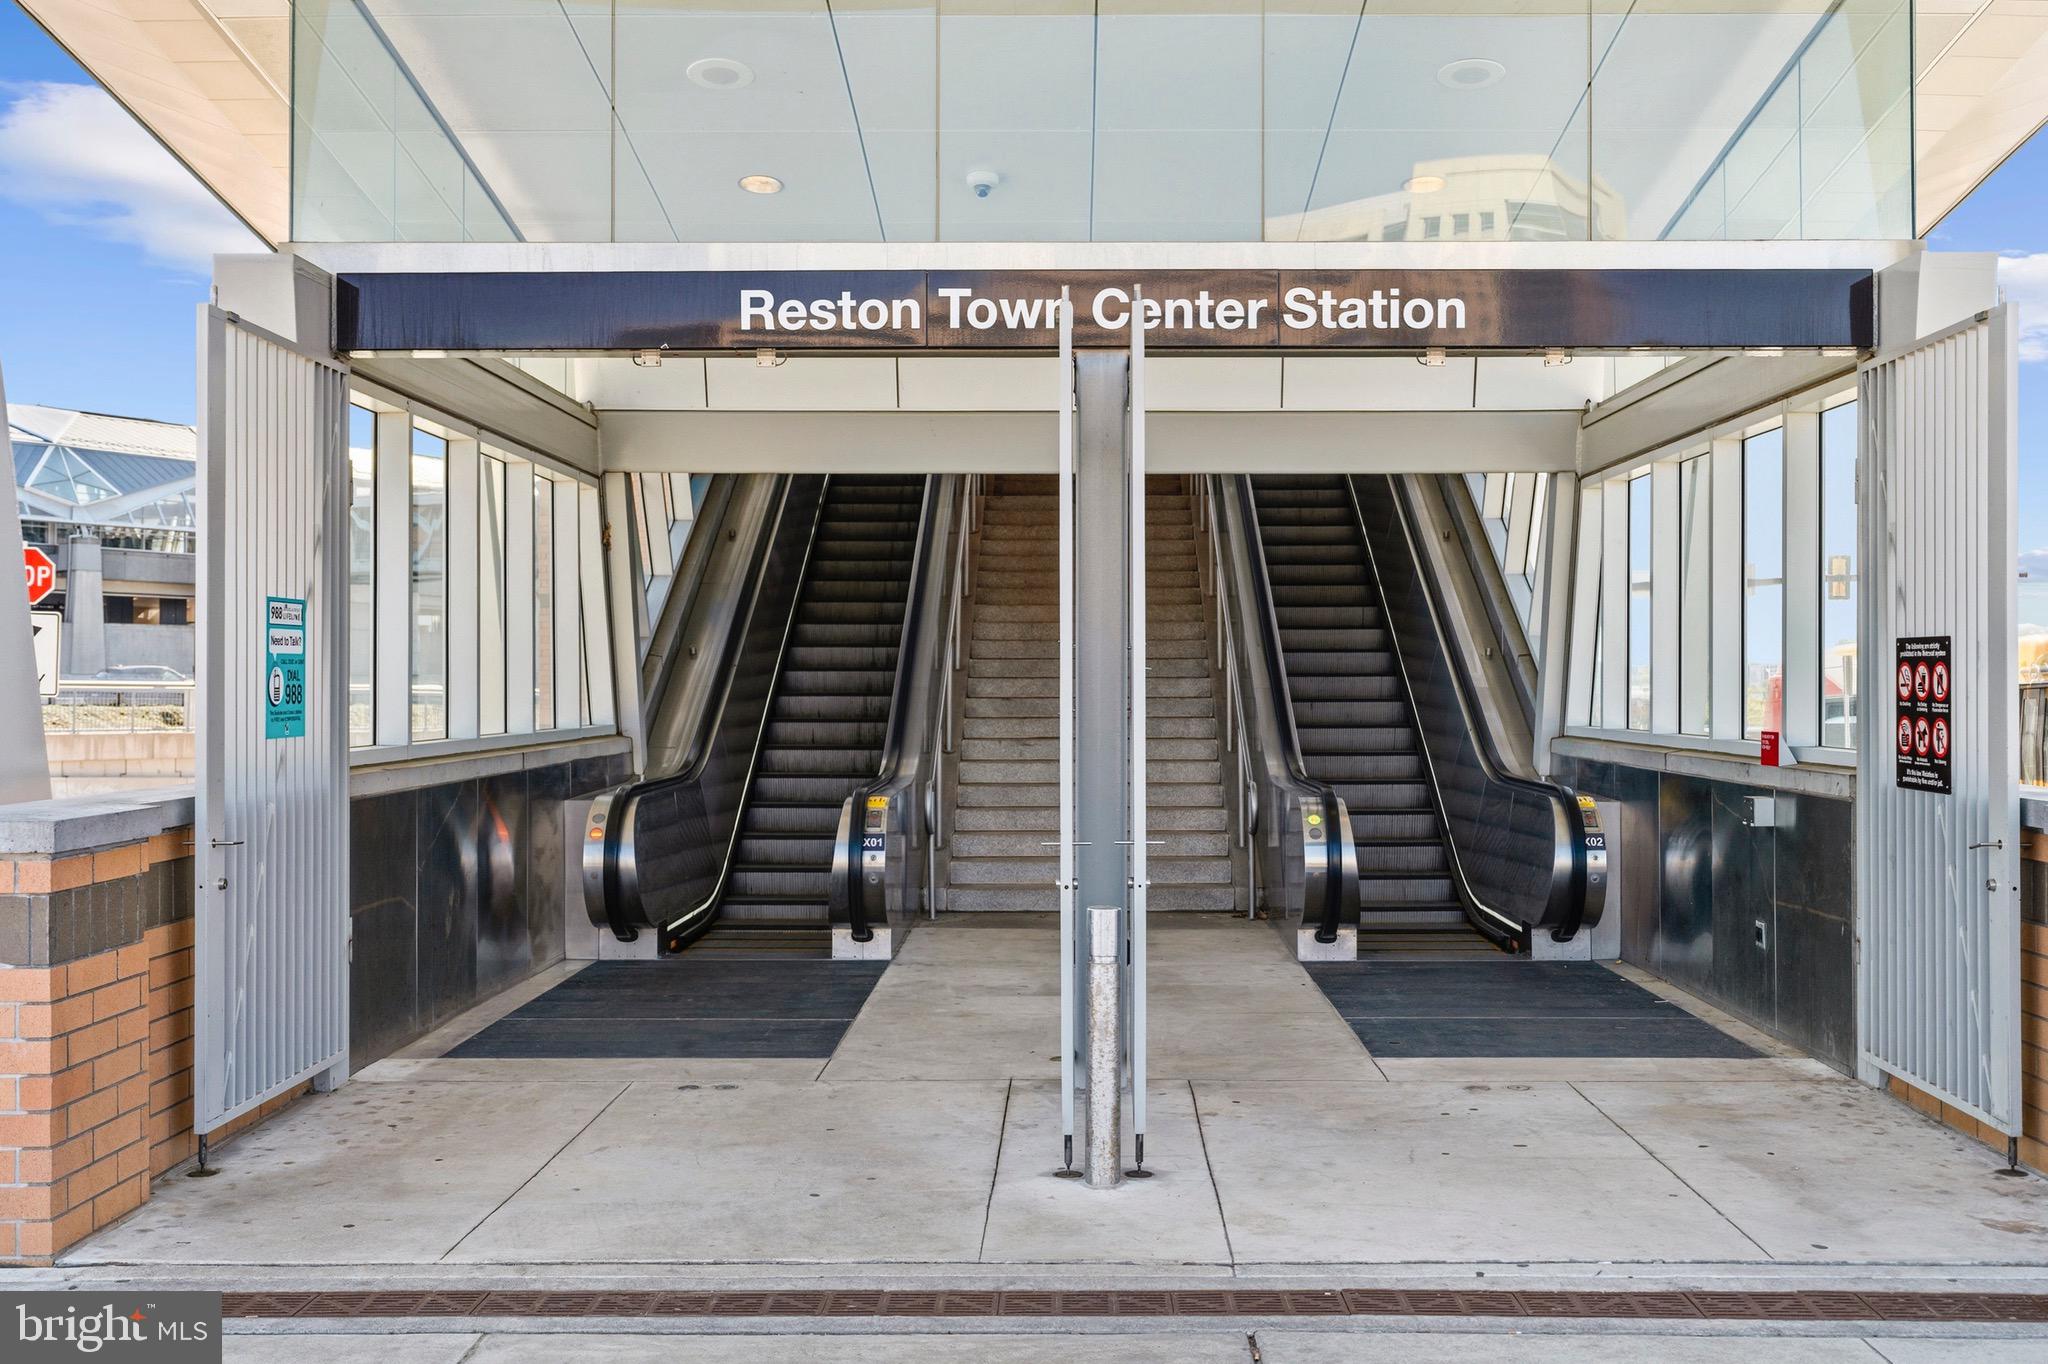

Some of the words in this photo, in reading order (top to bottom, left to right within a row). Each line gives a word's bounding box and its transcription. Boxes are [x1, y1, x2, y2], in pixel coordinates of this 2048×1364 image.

[740, 289, 920, 330] Reston
[939, 289, 1073, 330] Town
[1092, 287, 1268, 330] Center
[1283, 287, 1466, 330] Station
[25, 565, 51, 587] OP
[271, 606, 283, 619] 988
[270, 635, 283, 646] Need
[284, 636, 290, 646] to
[290, 636, 302, 646] Talk?
[287, 670, 301, 681] DIAL
[285, 684, 302, 704] 988
[863, 837, 883, 847] X01
